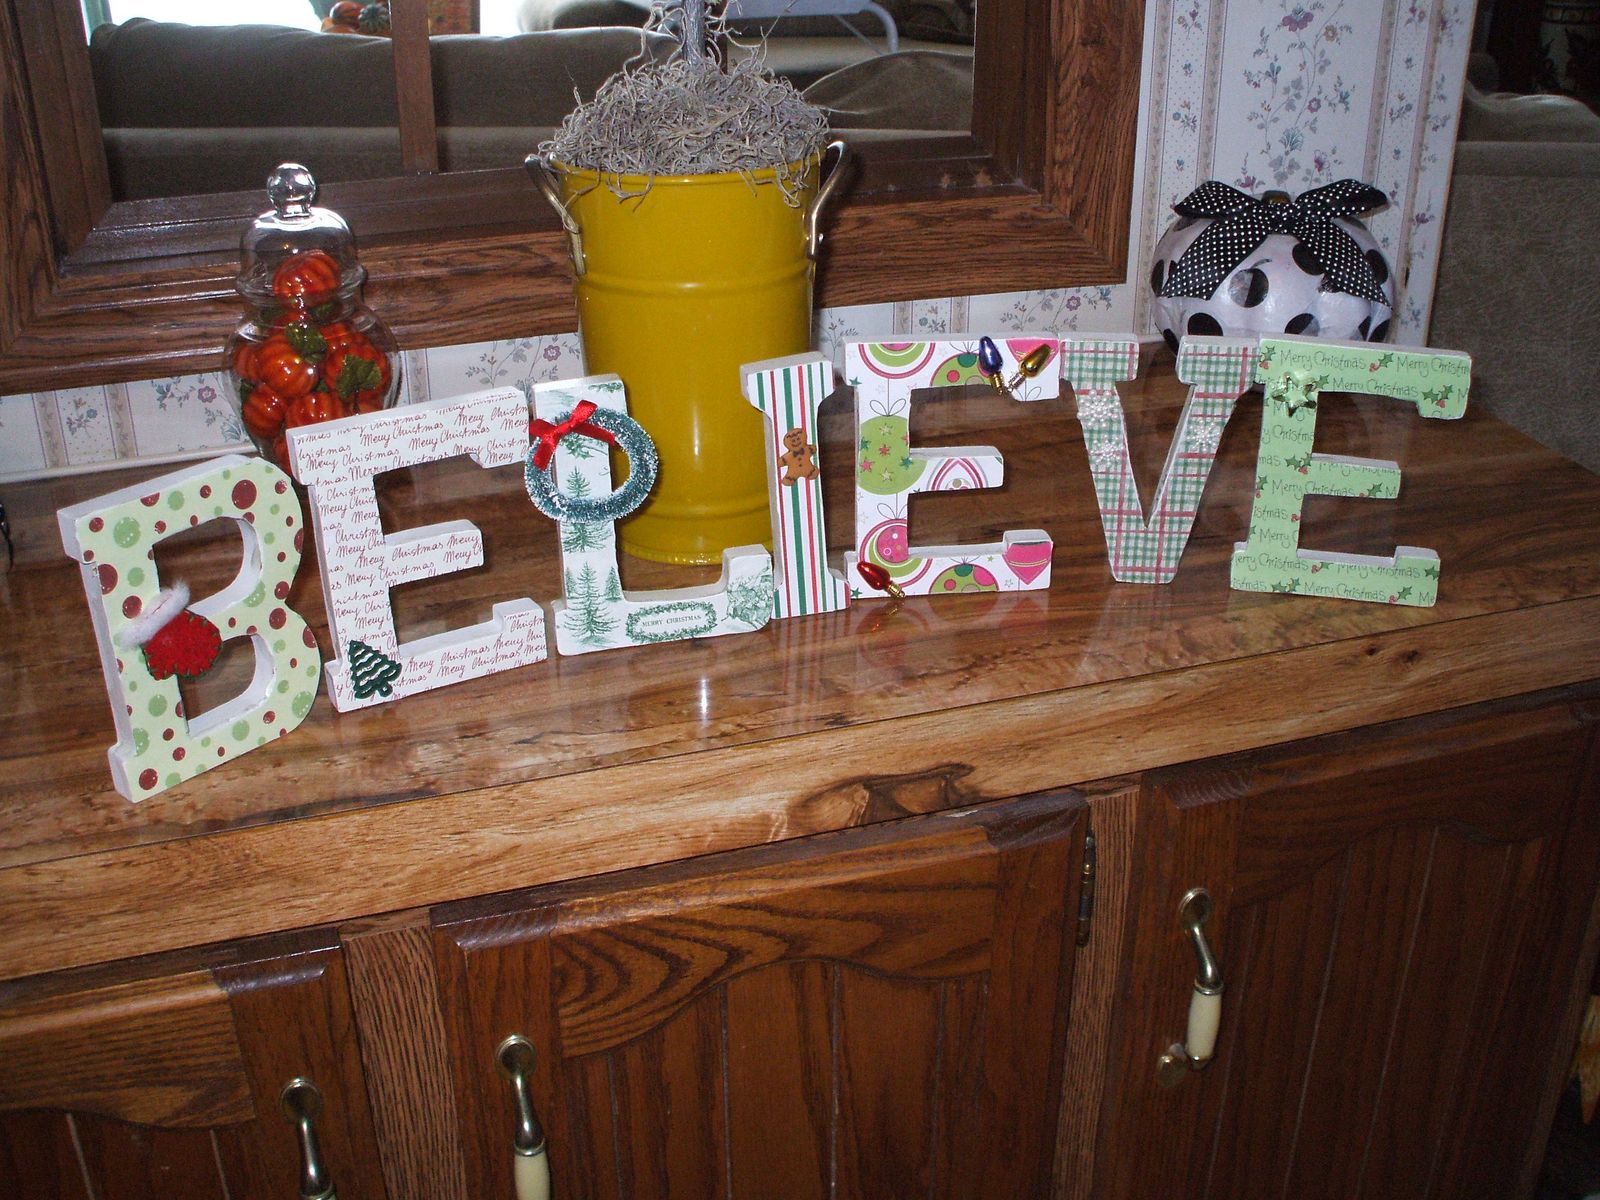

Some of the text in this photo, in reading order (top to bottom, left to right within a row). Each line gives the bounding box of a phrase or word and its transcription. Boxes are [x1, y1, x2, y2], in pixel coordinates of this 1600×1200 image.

[1280, 350, 1312, 371] Merry
[1314, 351, 1366, 371] Christmas
[1397, 356, 1429, 377] Merry
[1366, 379, 1419, 398] Christmas
[360, 432, 390, 448] Merry
[392, 422, 444, 440] Christmas
[453, 413, 485, 428] Merry
[306, 459, 338, 474] Merry
[343, 448, 399, 467] Christmas
[409, 438, 438, 452] Merry
[440, 426, 490, 443] Christmas
[485, 450, 514, 464] Merry
[1272, 480, 1301, 500] Merry
[320, 504, 347, 519] Merry
[1260, 528, 1290, 549] Merry
[336, 545, 365, 558] Merry
[355, 556, 384, 569] Merry
[392, 543, 443, 561] Christmas
[447, 533, 480, 548] Merry
[345, 573, 376, 587] Merry
[380, 562, 435, 580] Christmas
[443, 551, 472, 564] Merry
[1259, 553, 1308, 571] Christmas
[1337, 583, 1387, 601] Christmas
[356, 616, 384, 630] Merry
[642, 615, 702, 627] MERRY CHRISTMAS
[405, 656, 434, 673] Merry
[441, 646, 490, 666] Christmas
[493, 633, 523, 650] Merry
[436, 664, 466, 678] Merry
[472, 652, 521, 670] Christmas
